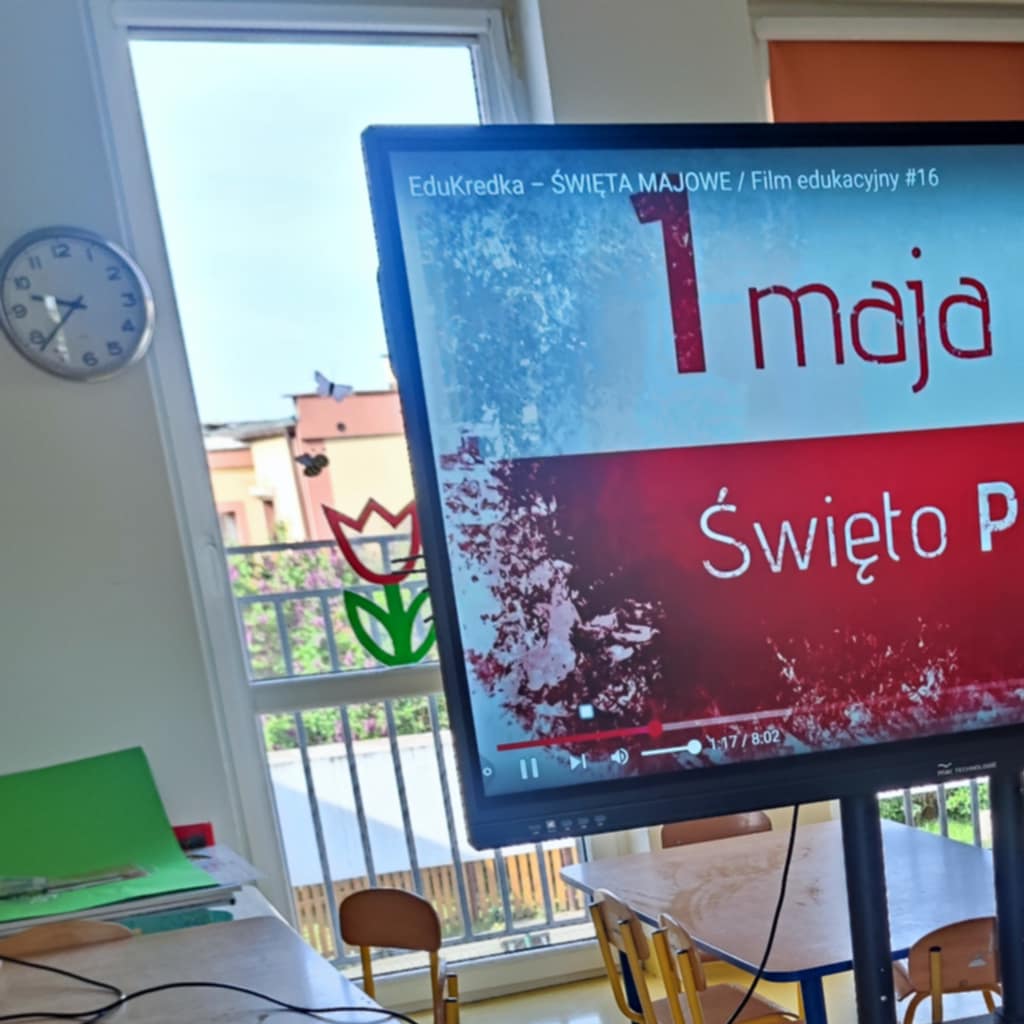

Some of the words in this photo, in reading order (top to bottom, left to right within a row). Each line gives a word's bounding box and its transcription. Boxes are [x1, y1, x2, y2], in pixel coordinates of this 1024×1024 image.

[408, 174, 525, 198] EduKredka
[551, 168, 634, 198] ŚWIĘTA
[638, 170, 733, 193] MAJOWE
[751, 169, 792, 191] Film
[797, 168, 900, 194] edukacyjny
[904, 168, 940, 188] #16
[629, 173, 707, 374] 1
[748, 247, 994, 394] maja
[700, 486, 949, 585] Święto
[709, 735, 738, 750] 1:17
[751, 729, 780, 745] 8:02
